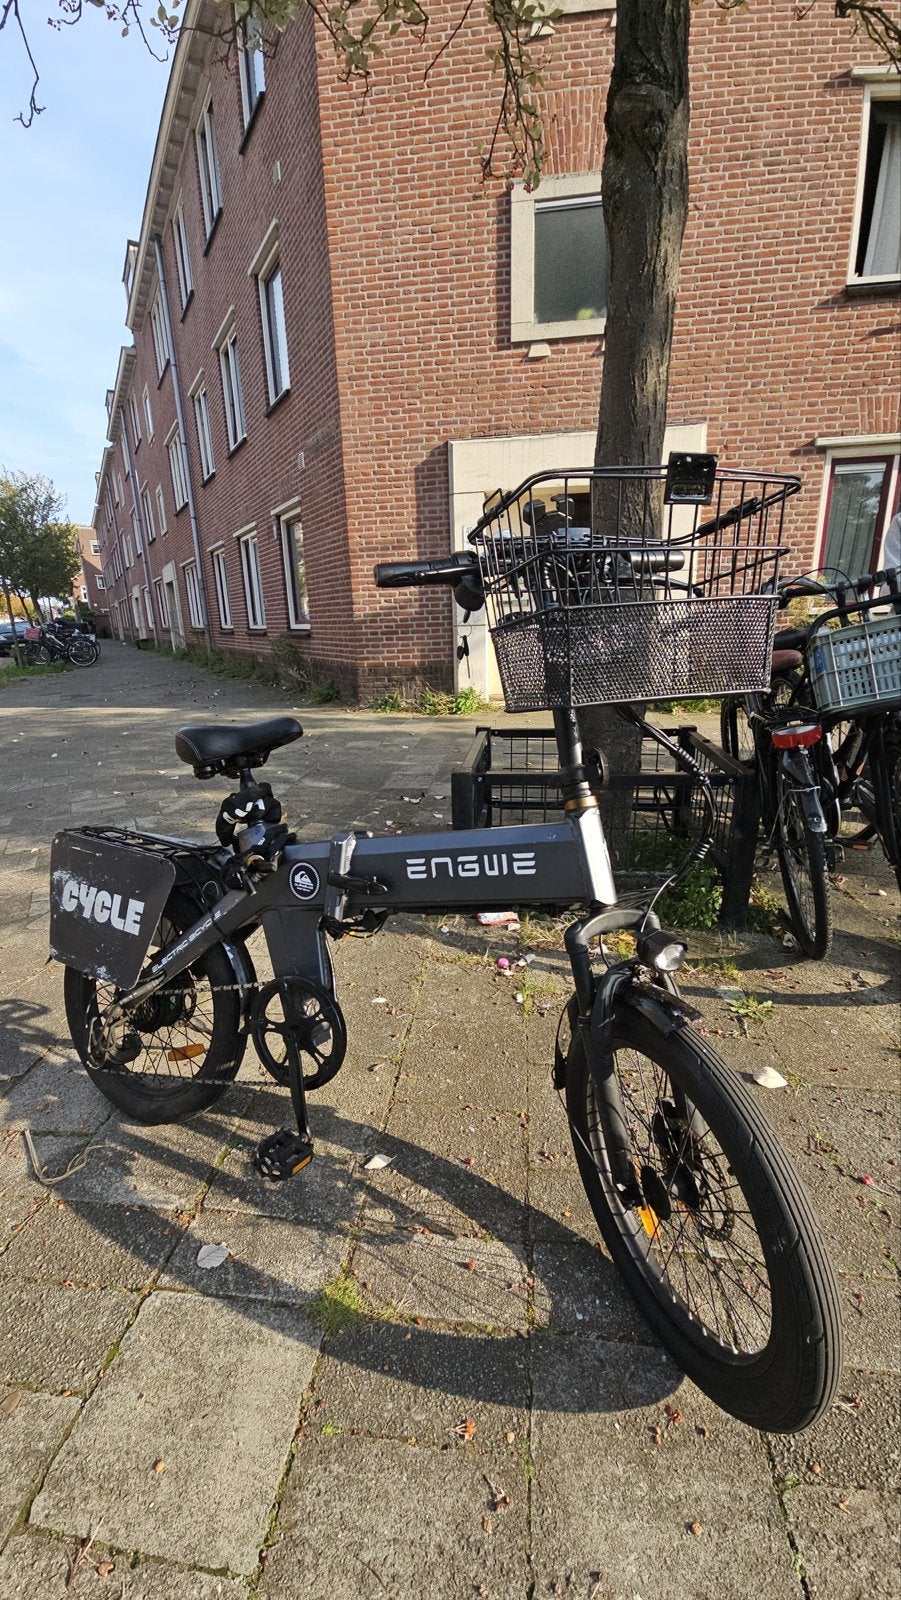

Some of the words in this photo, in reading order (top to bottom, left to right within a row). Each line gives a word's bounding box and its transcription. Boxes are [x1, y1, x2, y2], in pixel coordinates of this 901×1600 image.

[406, 852, 537, 880] ENGWE
[62, 880, 145, 936] CYCLE
[151, 939, 189, 973] ELECTRIC
